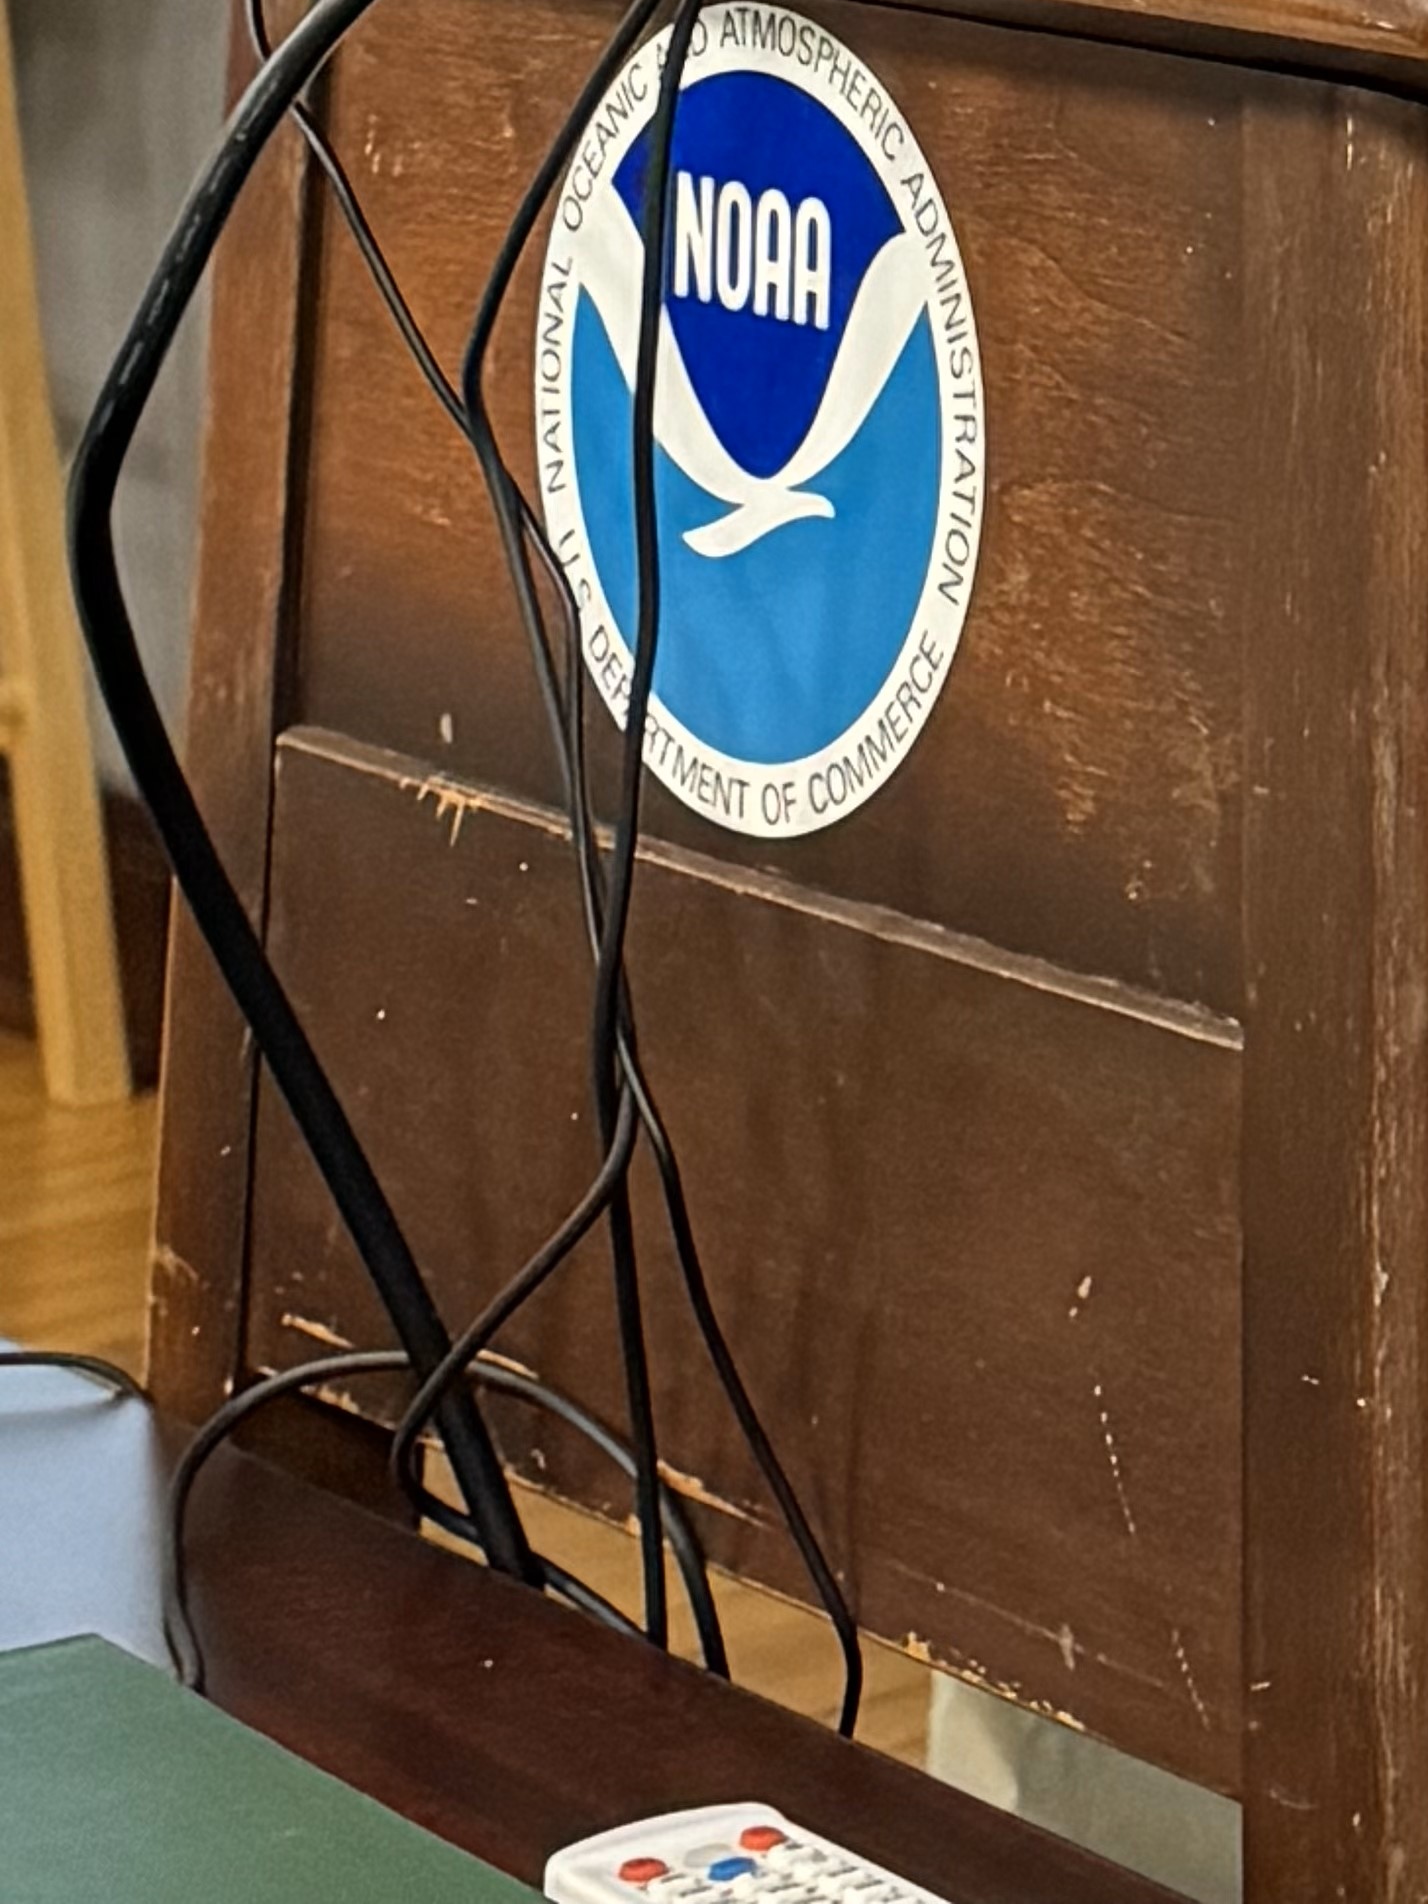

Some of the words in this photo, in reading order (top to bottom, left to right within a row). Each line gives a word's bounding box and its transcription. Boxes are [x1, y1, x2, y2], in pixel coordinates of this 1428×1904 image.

[541, 255, 573, 494] NATIONAL
[561, 62, 650, 233] OCEANIC
[719, 6, 907, 162] ATMOSPHERIC
[900, 171, 979, 607] ADMINISTRATION
[674, 170, 832, 332] NOAA
[588, 624, 750, 819] DEPRTMENT
[760, 781, 798, 826] OF
[807, 629, 945, 816] COMMERCE
